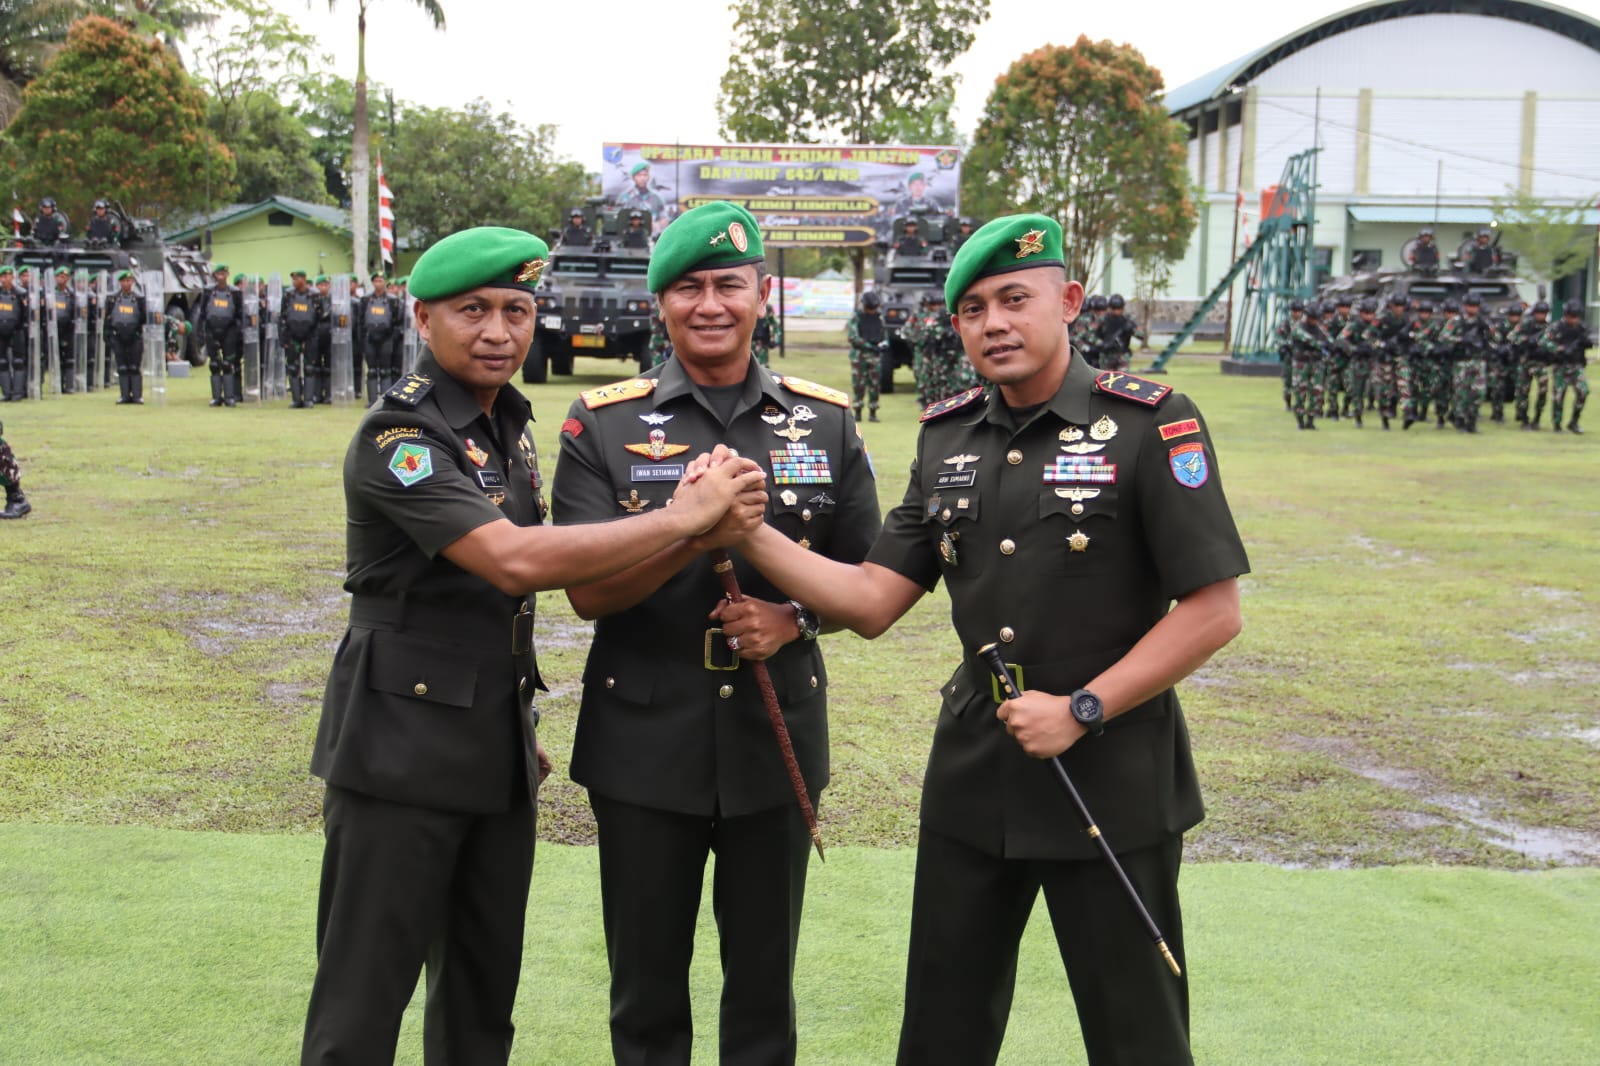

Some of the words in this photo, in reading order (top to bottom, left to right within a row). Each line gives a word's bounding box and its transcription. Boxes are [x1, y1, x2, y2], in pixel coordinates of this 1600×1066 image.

[640, 146, 714, 161] UPACARA
[720, 148, 773, 162] SERAH
[778, 149, 841, 163] TERIMA
[849, 150, 919, 164] JABATAN
[700, 165, 780, 181] DANYONIF
[785, 168, 859, 182] 643/WNS
[376, 427, 419, 443] RAIDER
[636, 469, 651, 477] IWAN
[652, 469, 680, 477] SETIAWAN
